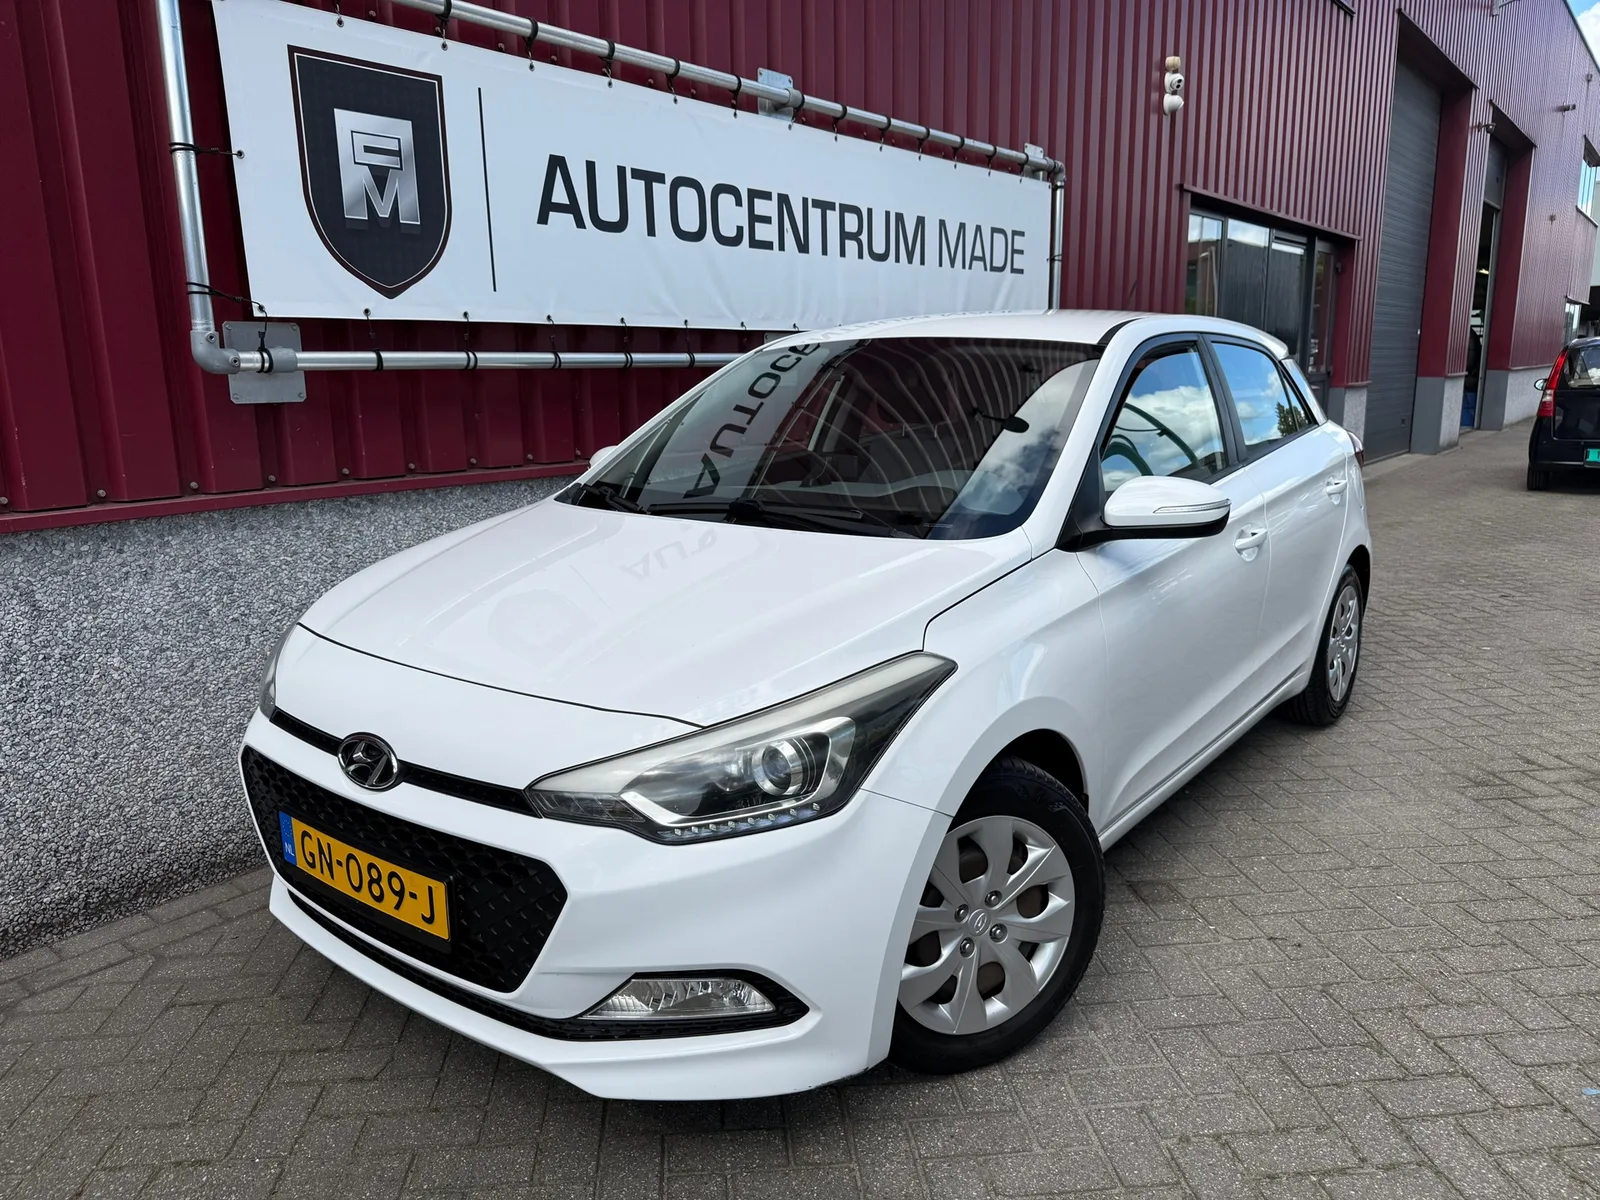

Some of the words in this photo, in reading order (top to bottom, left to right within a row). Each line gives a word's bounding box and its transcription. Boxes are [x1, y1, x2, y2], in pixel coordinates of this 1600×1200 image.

[537, 154, 926, 266] AUTOCENTRUM
[938, 218, 1026, 275] MADE
[284, 841, 295, 858] NL
[300, 829, 436, 925] GN-089-J
